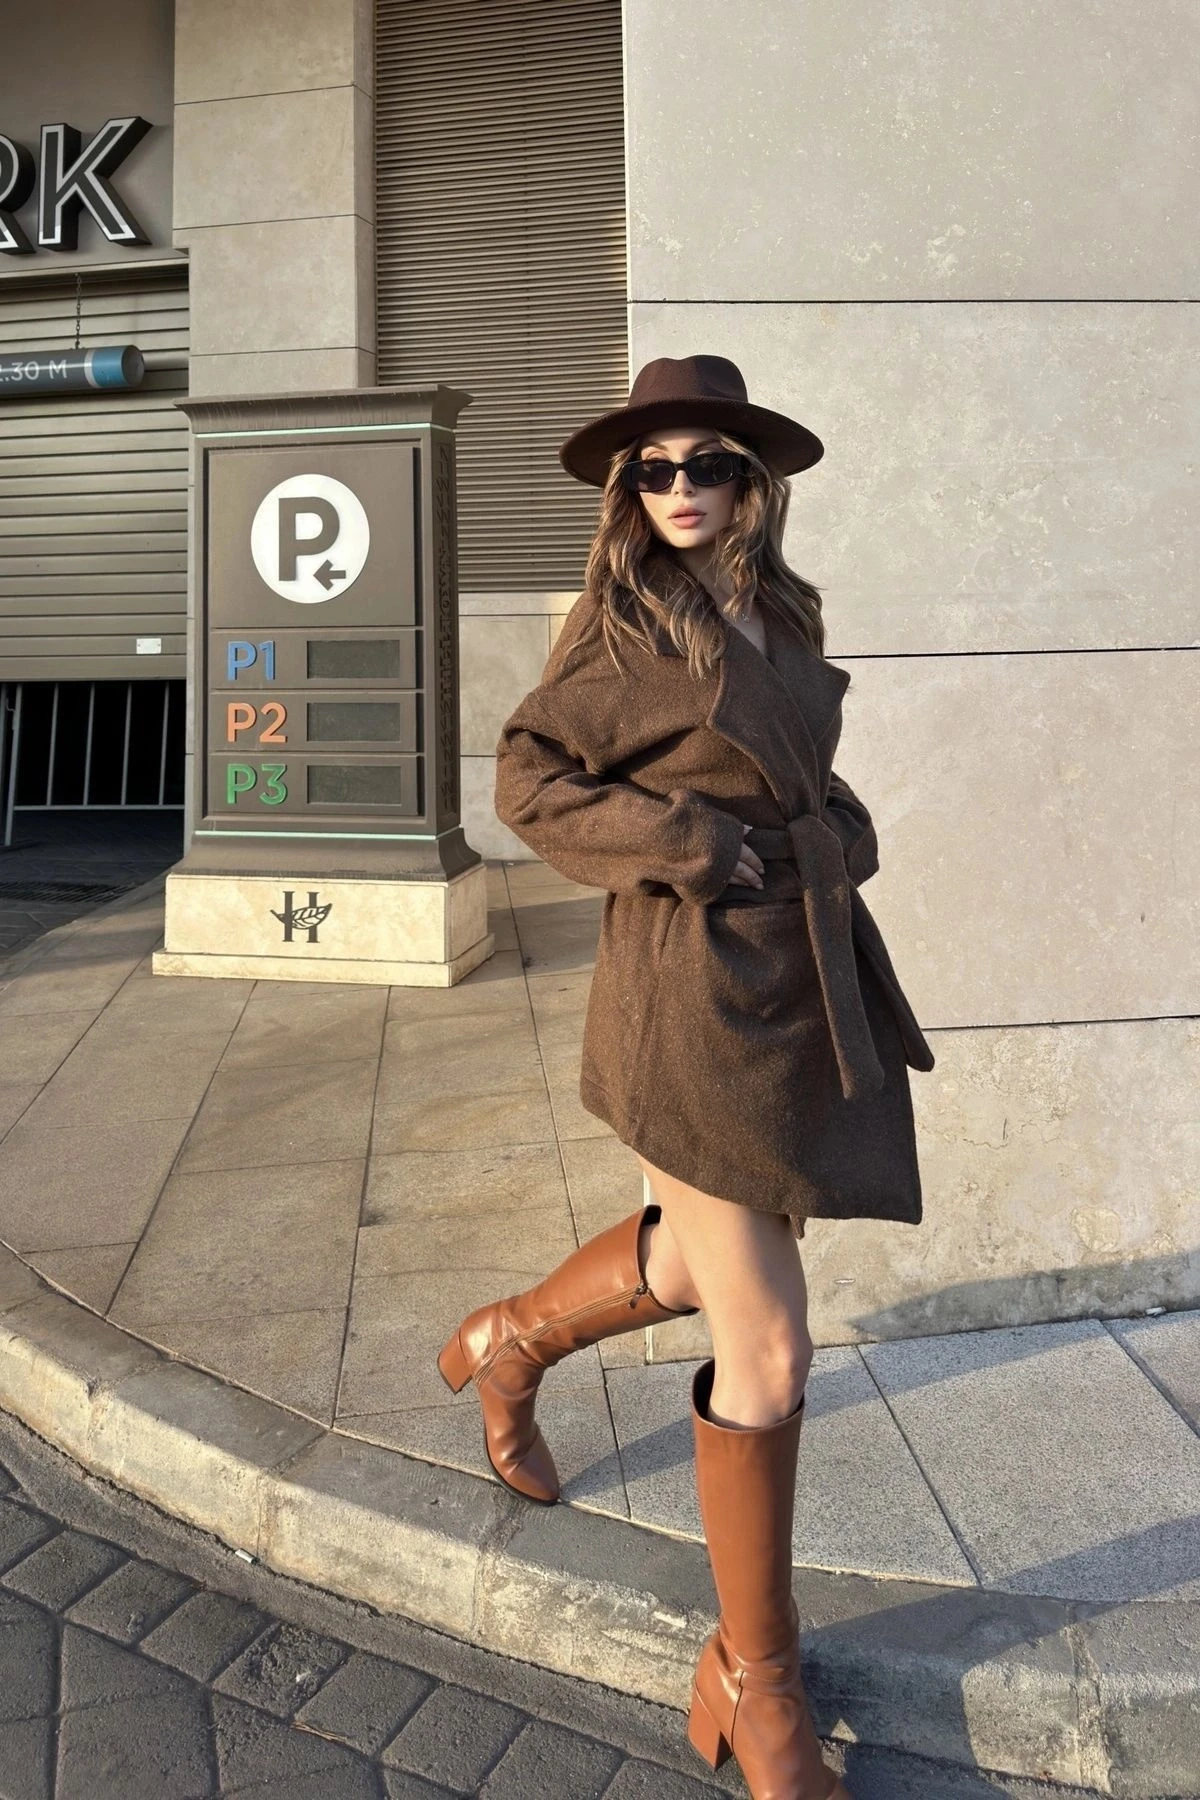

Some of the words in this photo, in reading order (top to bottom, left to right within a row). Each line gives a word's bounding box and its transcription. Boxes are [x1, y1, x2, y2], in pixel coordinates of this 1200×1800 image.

[0, 116, 152, 253] K
[0, 361, 40, 382] .30
[49, 359, 67, 379] M
[278, 496, 340, 582] P
[227, 640, 276, 681] P1
[227, 702, 288, 744] P2
[227, 763, 288, 805] P3
